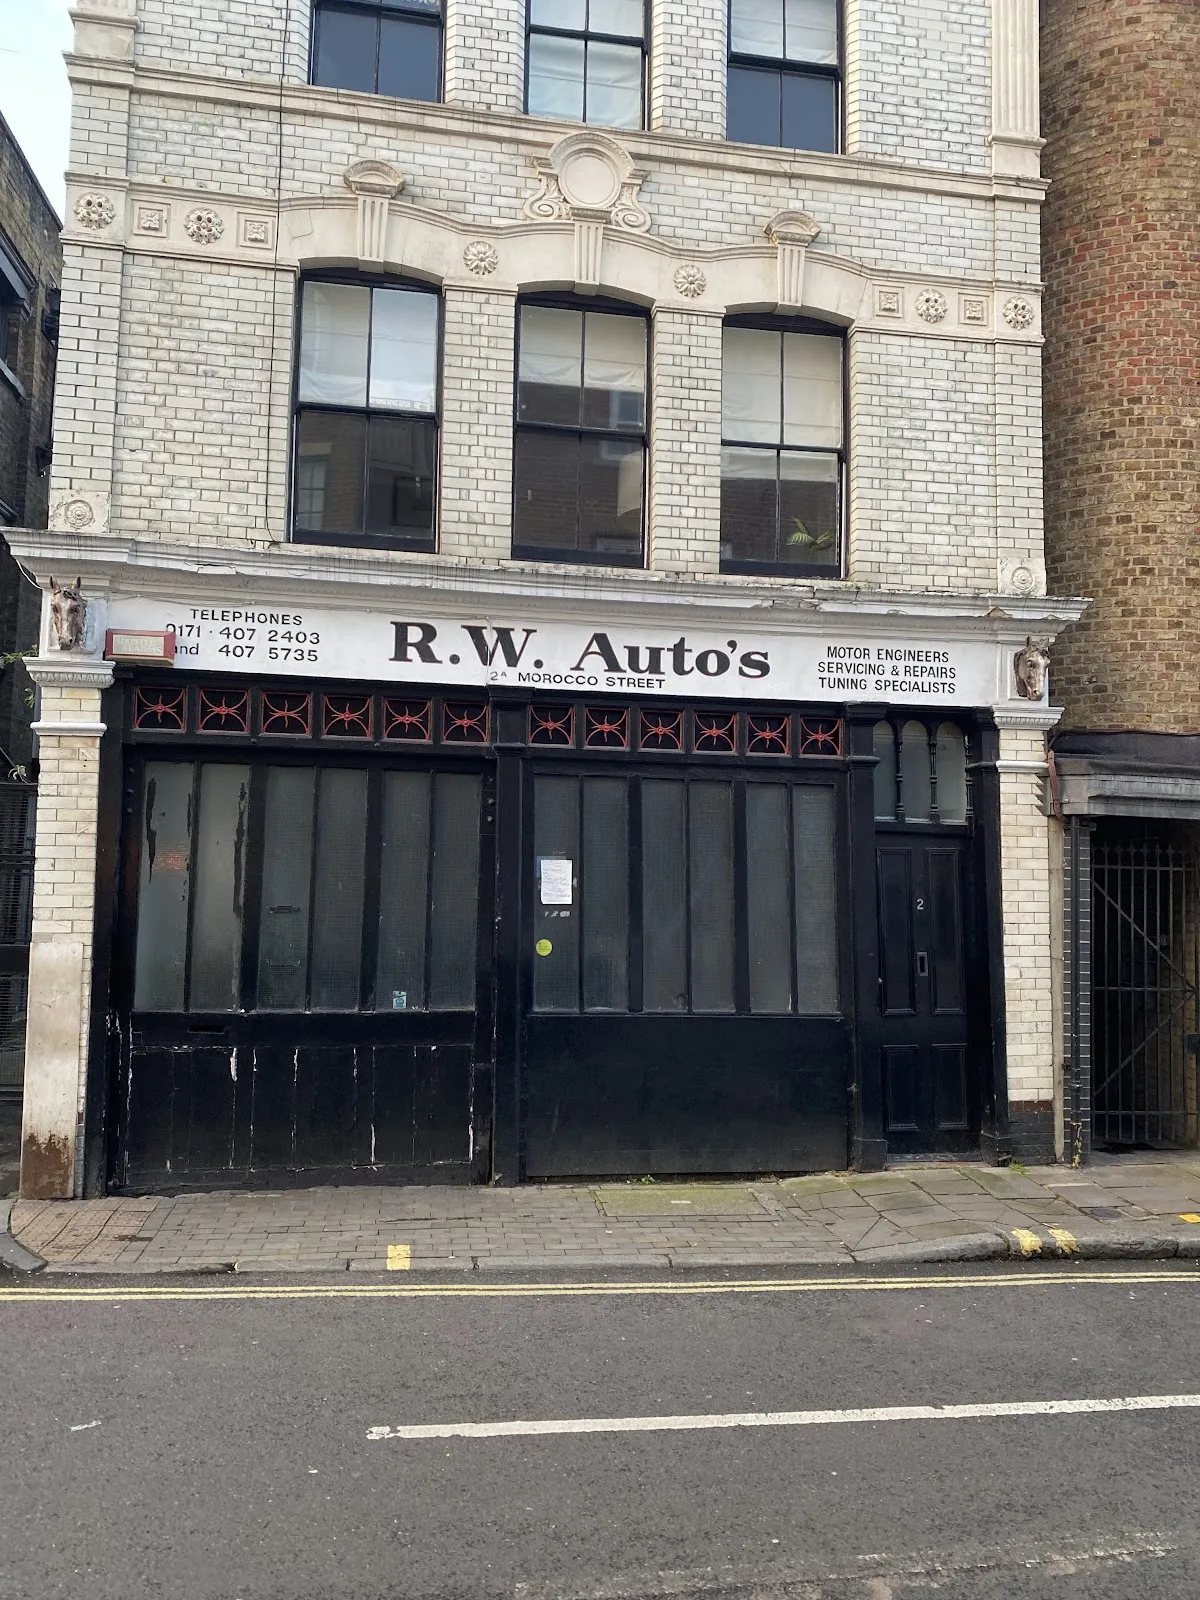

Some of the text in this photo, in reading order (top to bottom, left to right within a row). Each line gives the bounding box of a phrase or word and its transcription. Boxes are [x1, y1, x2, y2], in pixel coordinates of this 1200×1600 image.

[189, 608, 303, 626] TELEPHONES
[218, 626, 257, 641] 407
[267, 629, 320, 645] 2403
[217, 644, 256, 659] 407
[268, 646, 319, 662] 5735
[388, 620, 771, 680] R.W. Auto's
[826, 646, 950, 663] MOTOR ENGINEERS
[817, 661, 957, 679] SERVICING & REPAIRS
[518, 672, 599, 688] MOROCCO
[605, 676, 666, 689] STREET
[818, 677, 956, 694] TUNING SPECIALISTS
[916, 898, 925, 910] 2
